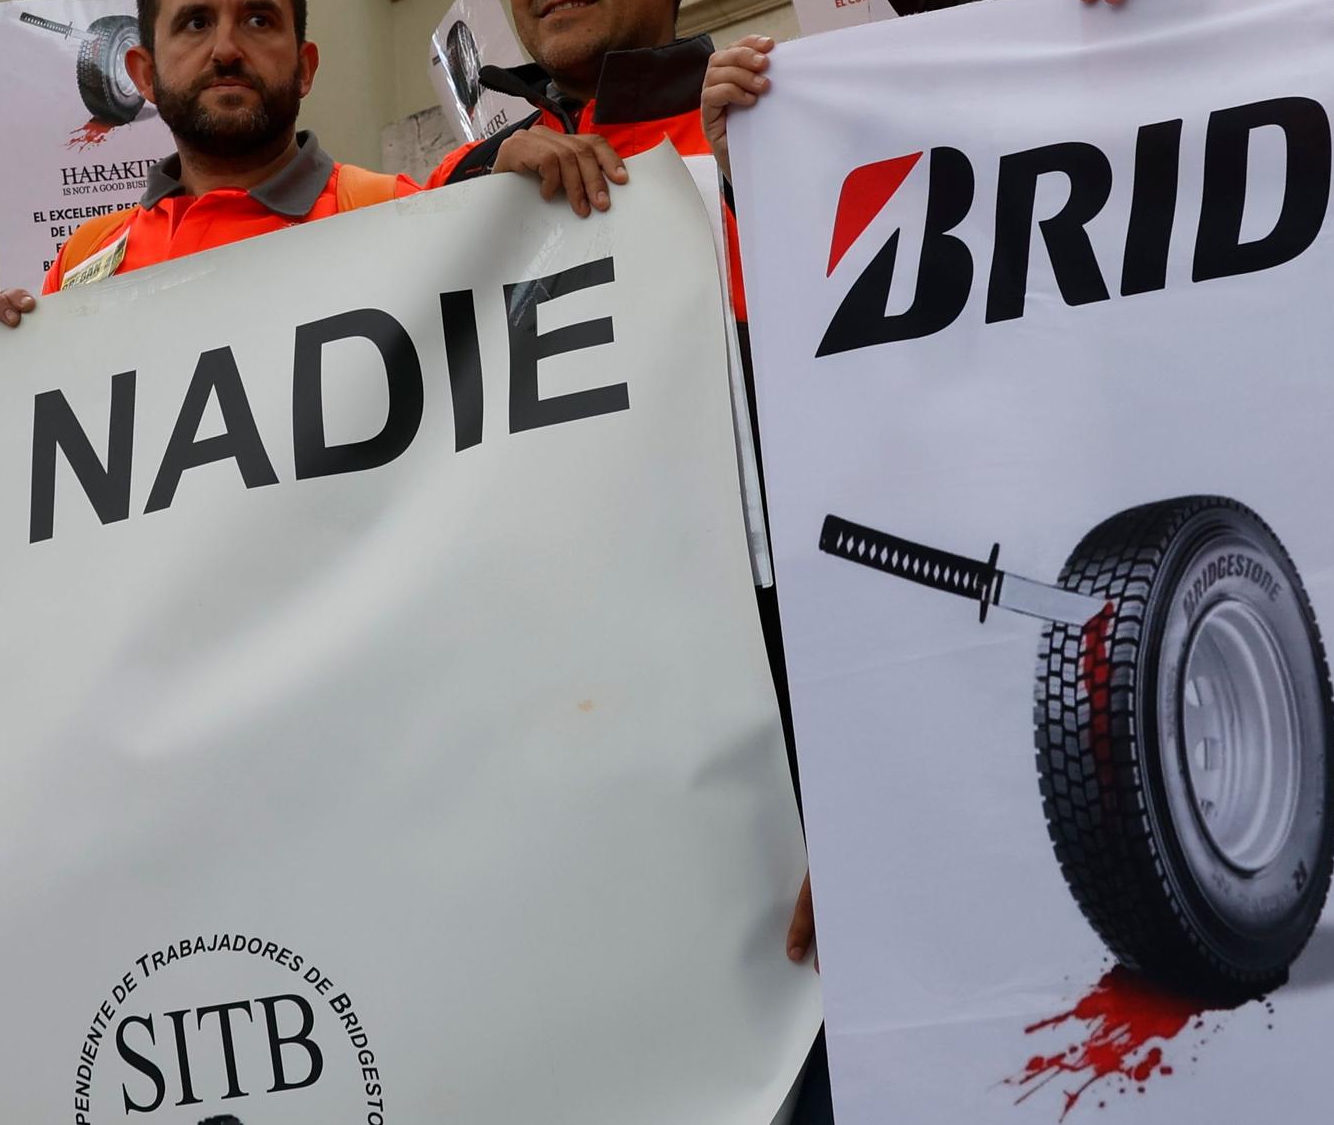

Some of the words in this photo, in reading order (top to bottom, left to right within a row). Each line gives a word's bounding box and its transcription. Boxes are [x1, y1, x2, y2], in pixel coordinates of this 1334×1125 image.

[61, 158, 163, 185] HARAKI
[63, 188, 72, 196] IS
[72, 185, 91, 195] NOT
[99, 182, 125, 192] GOOD
[33, 211, 47, 223] EL
[49, 204, 113, 221] EXCELENTE
[51, 225, 65, 237] DE
[29, 256, 630, 544] NADIE
[112, 972, 138, 1005] DE
[135, 933, 304, 978] TRABAJADORES
[303, 966, 333, 996] DE
[115, 993, 324, 1115] SITB
